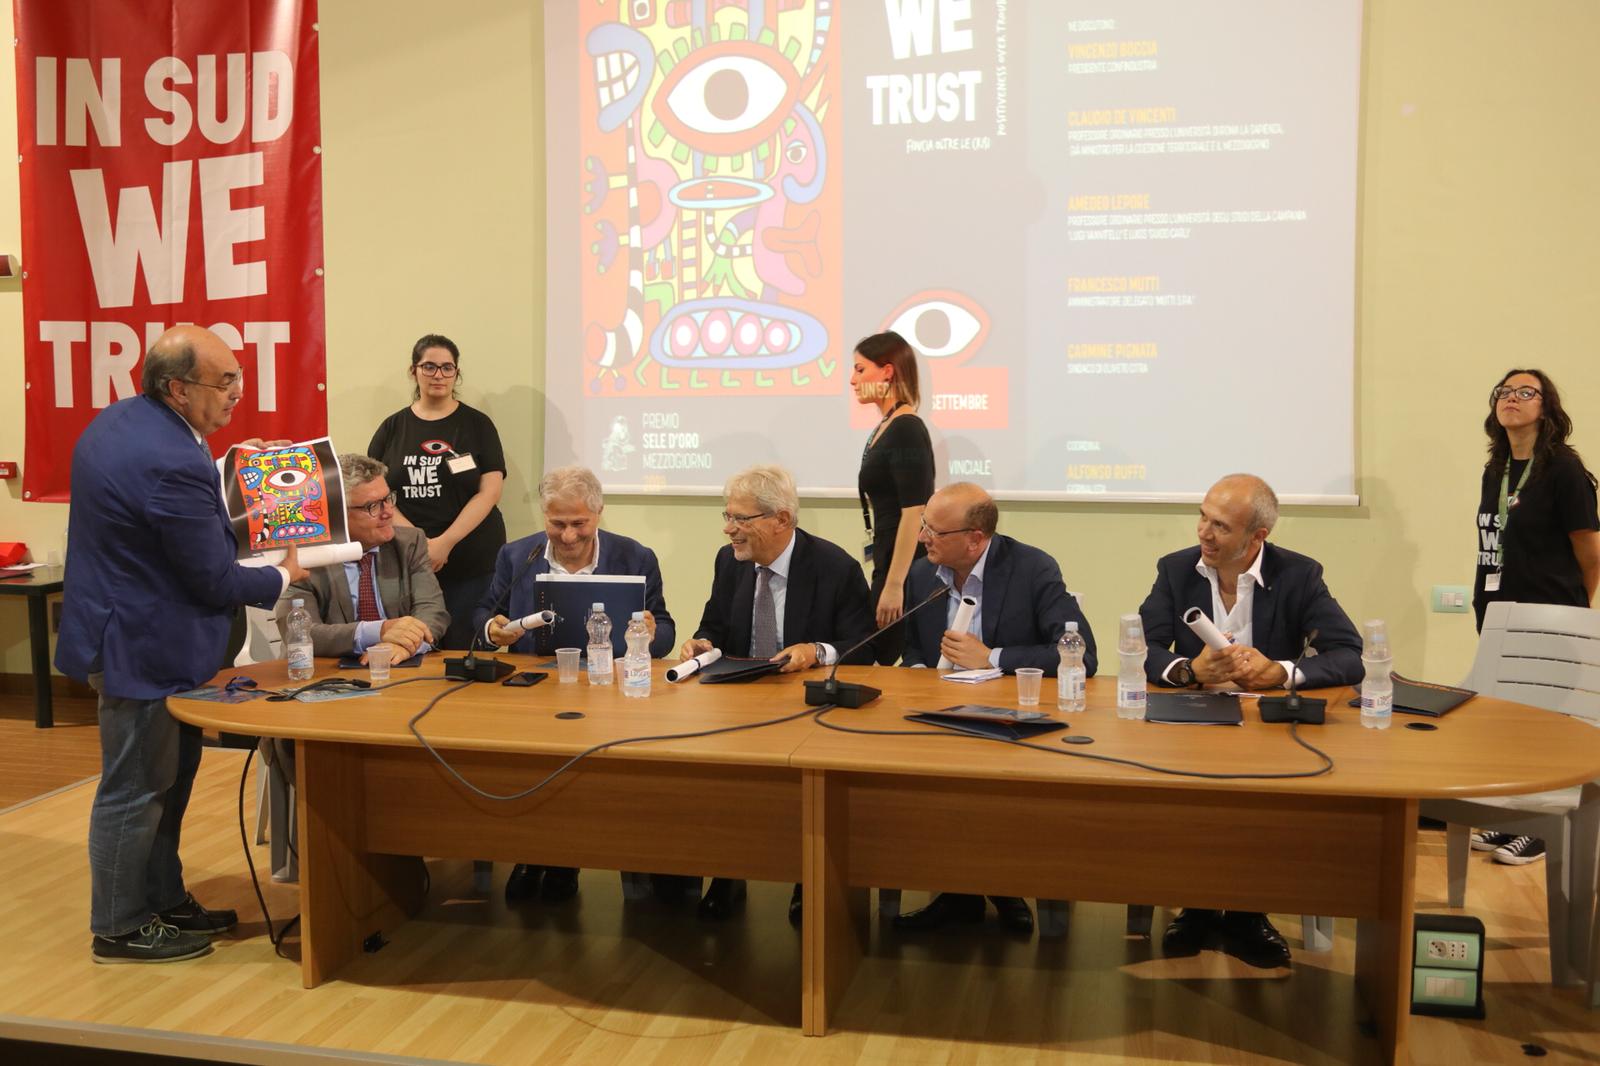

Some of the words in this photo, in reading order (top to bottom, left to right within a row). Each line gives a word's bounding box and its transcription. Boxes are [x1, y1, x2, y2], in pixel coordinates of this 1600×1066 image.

[885, 0, 973, 59] WE
[36, 57, 122, 147] IN
[144, 49, 295, 146] SUD
[866, 70, 982, 125] TRUST
[69, 151, 268, 309] WE
[39, 321, 290, 412] TRT
[641, 411, 680, 430] PREMIO
[642, 432, 667, 449] SELE
[668, 431, 701, 449] D'ORO
[403, 455, 417, 466] IN
[419, 455, 442, 466] SUD
[642, 452, 713, 470] MEZZOGIORNO
[408, 466, 439, 486] WE
[402, 484, 442, 499] TRUST
